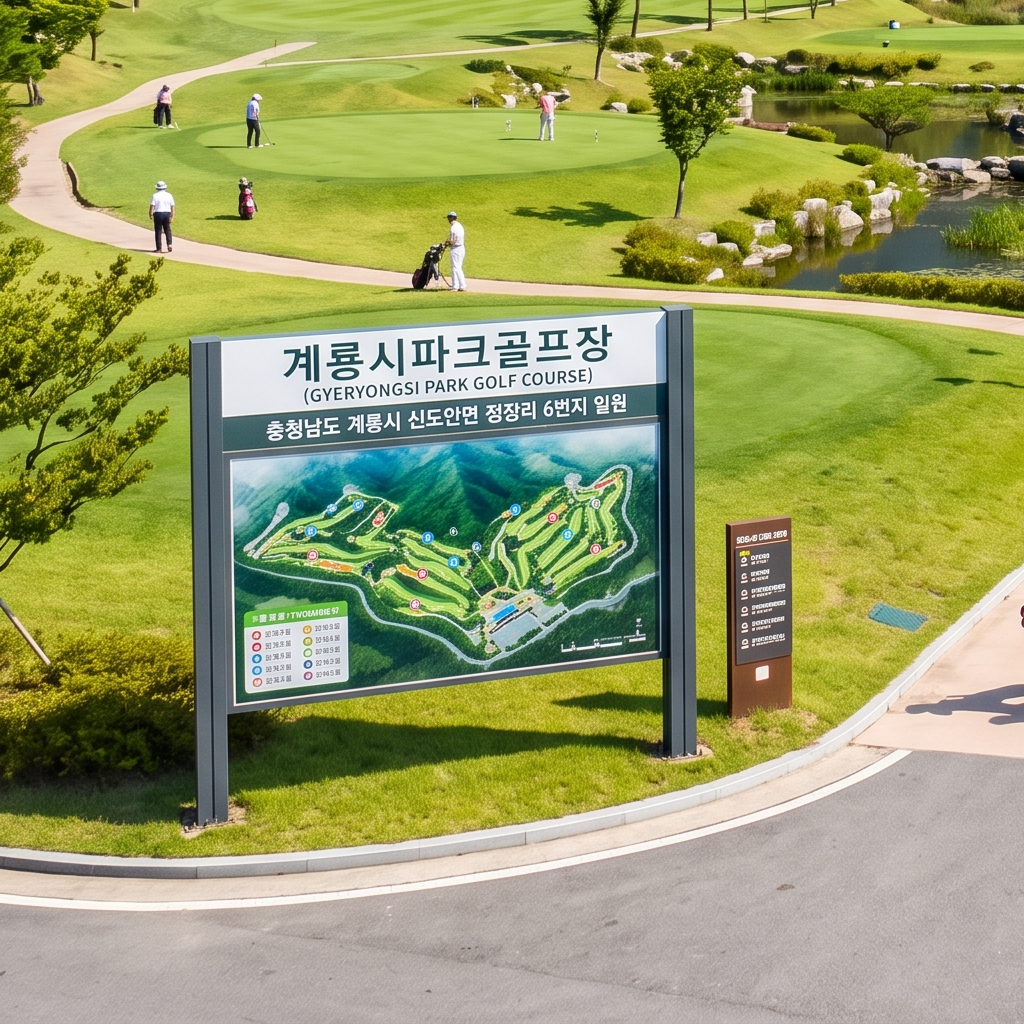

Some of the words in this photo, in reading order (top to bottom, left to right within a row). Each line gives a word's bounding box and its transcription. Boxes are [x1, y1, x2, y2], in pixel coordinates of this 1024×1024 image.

[283, 324, 613, 383] 계룡시파크골프장
[304, 381, 419, 406] (GYERYONGSI
[425, 377, 468, 394] PARK
[473, 373, 517, 390] GOLF
[522, 367, 593, 387] COURSE)
[266, 416, 341, 442] 충청남도
[408, 404, 479, 430] 신도안면
[485, 400, 537, 425] 정장리
[543, 396, 587, 418] 6번지
[593, 393, 627, 415] 일원
